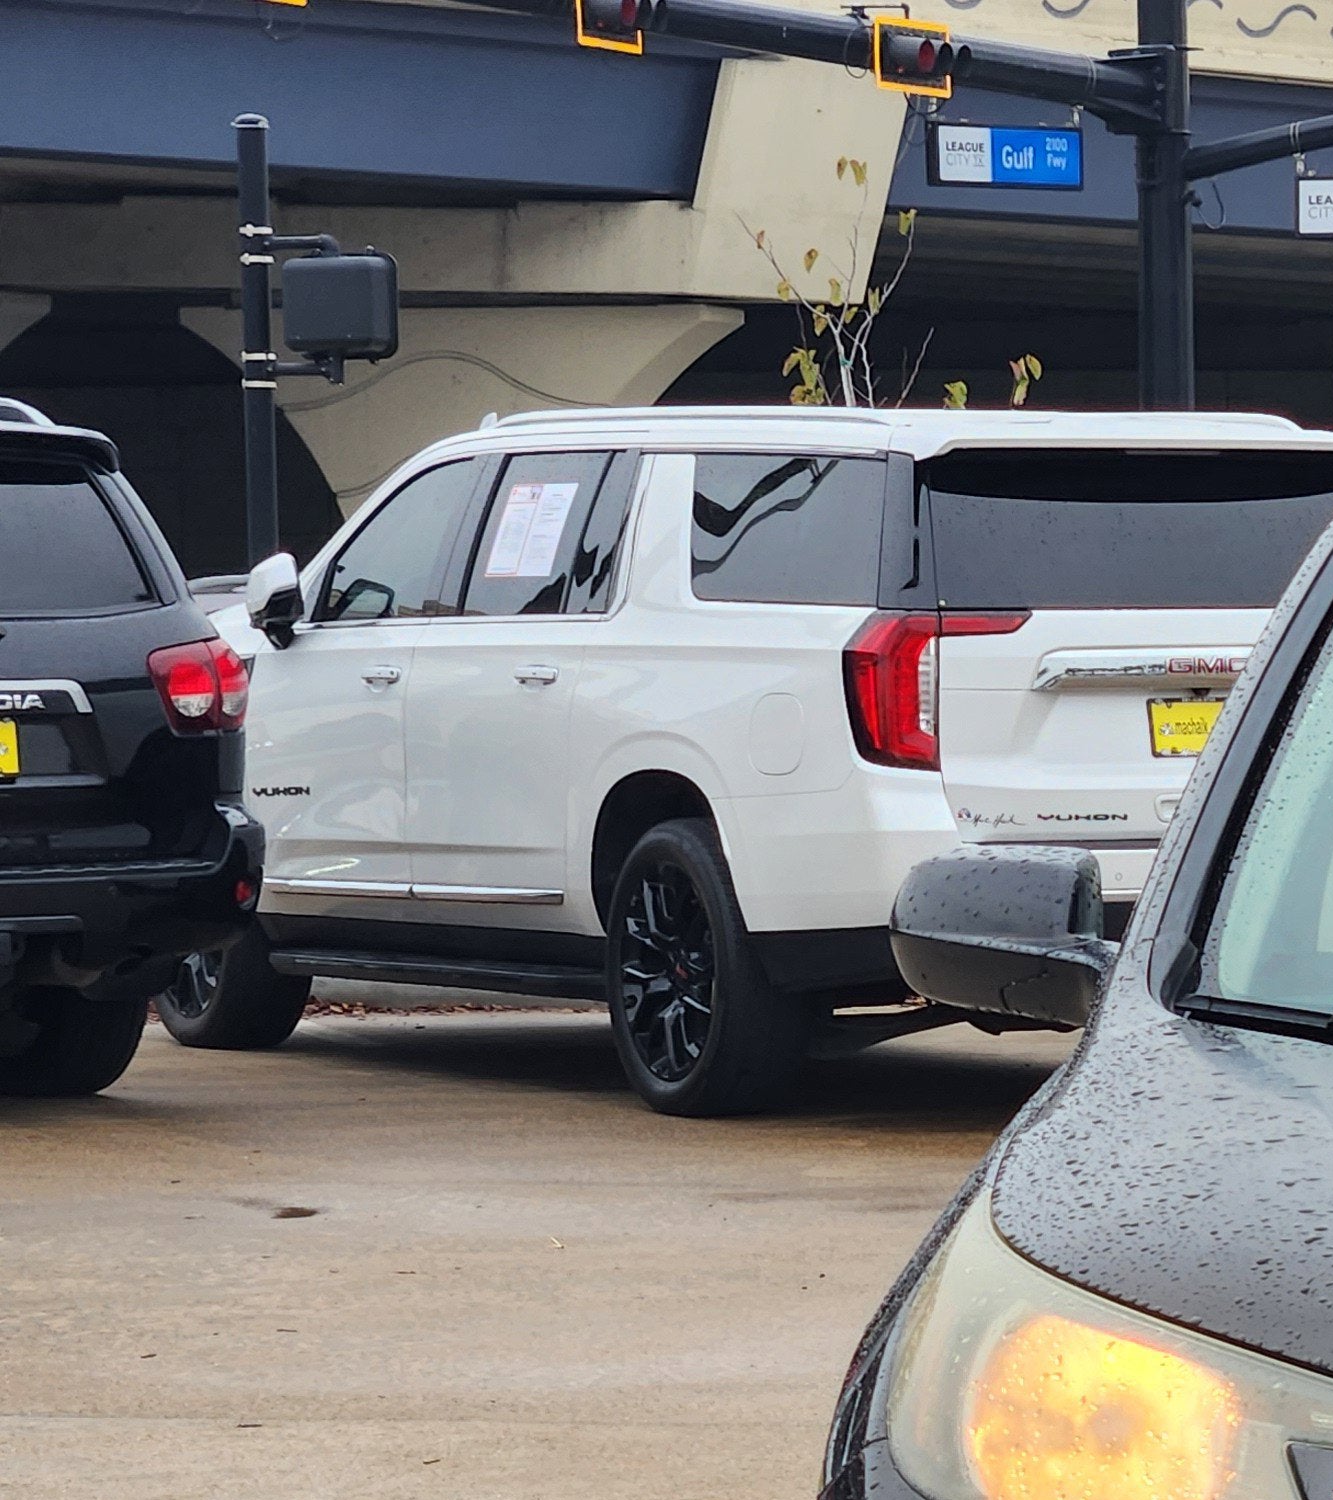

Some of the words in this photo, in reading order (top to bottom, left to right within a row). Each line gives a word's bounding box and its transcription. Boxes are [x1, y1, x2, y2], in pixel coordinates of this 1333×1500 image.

[945, 141, 985, 152] LEAGUE
[945, 153, 969, 167] CITY
[1001, 144, 1035, 170] Gulf
[1046, 153, 1067, 171] Fwy
[1168, 658, 1248, 674] GMC
[252, 786, 310, 797] YUKON
[1037, 813, 1128, 822] YUKON
